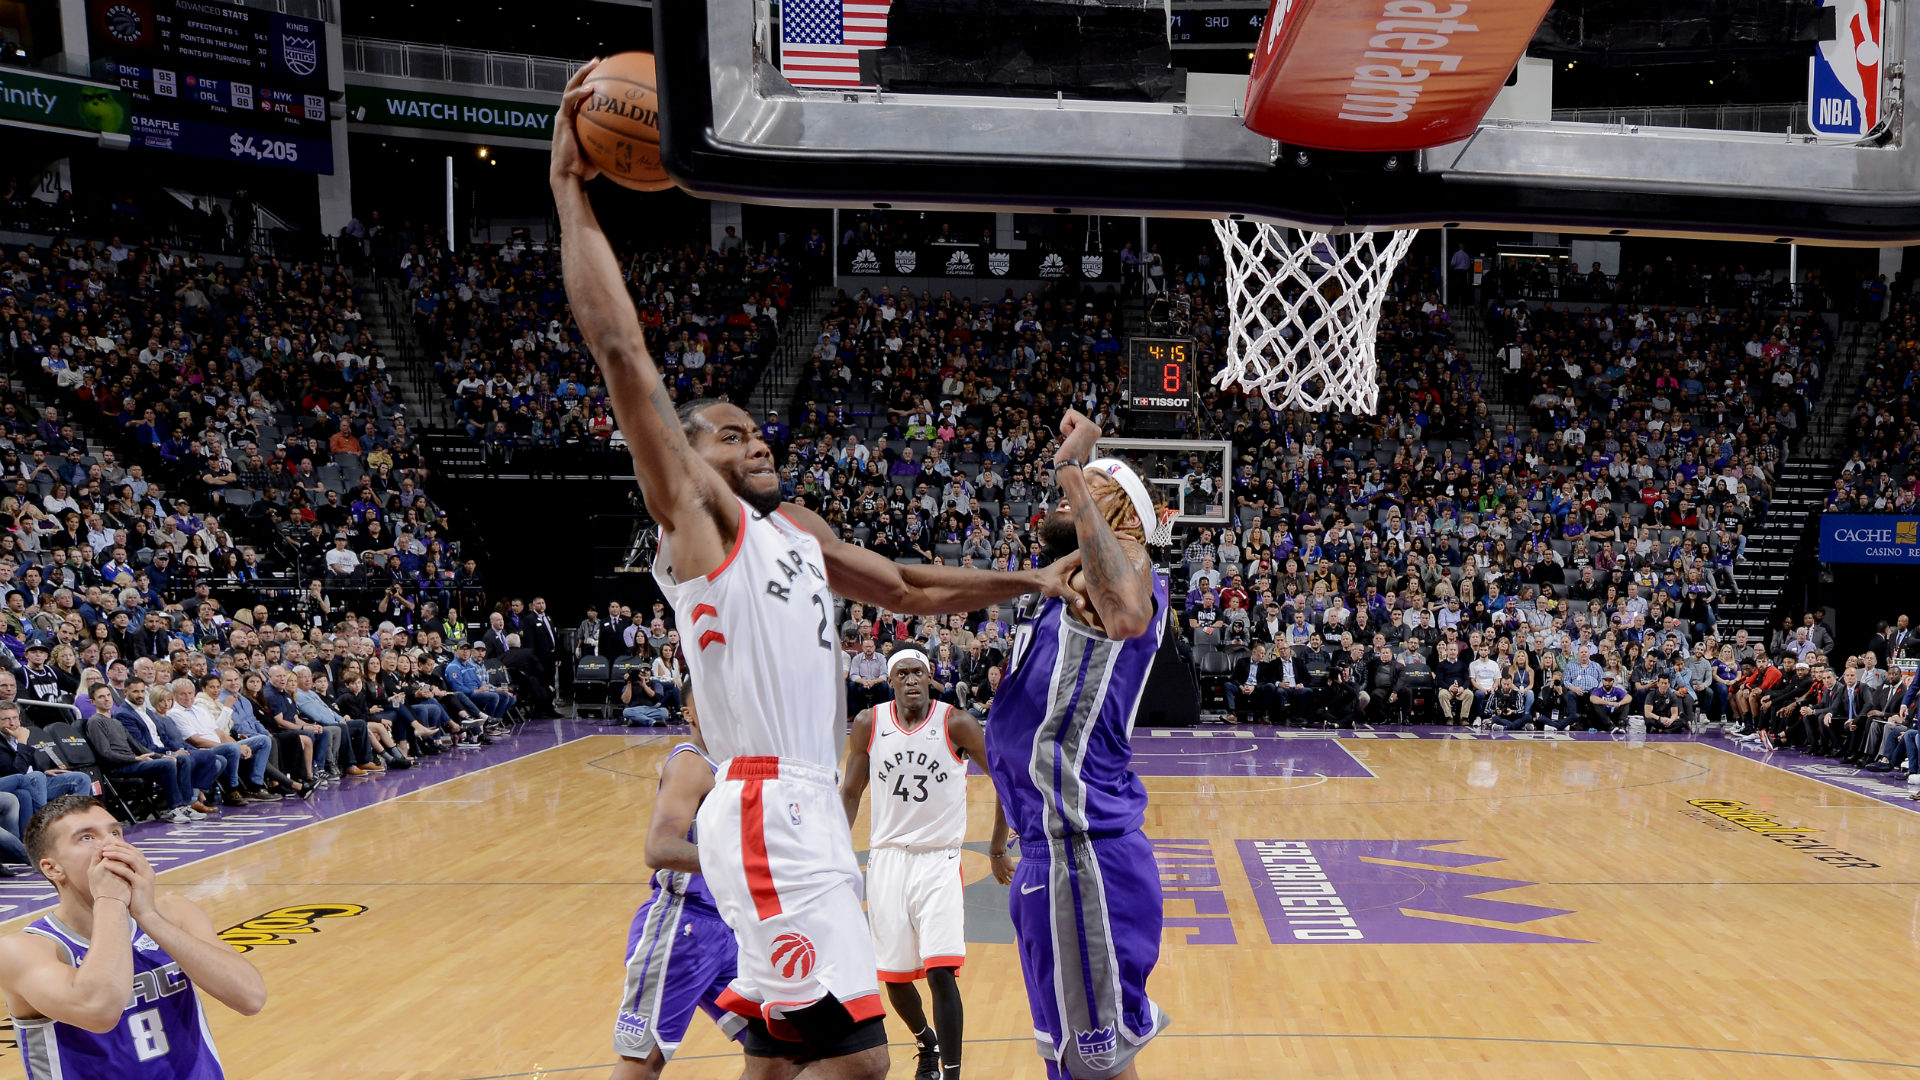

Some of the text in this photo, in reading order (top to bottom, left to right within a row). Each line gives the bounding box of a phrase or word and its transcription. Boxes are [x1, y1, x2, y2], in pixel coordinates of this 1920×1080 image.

[175, 0, 248, 21] ADVANCED STATS
[187, 20, 223, 33] EFFECTIVE
[286, 22, 309, 33] KINGS
[1204, 16, 1230, 27] 3RD
[180, 33, 205, 44] POINTS
[215, 39, 228, 48] THE
[229, 42, 248, 51] PAINT
[179, 47, 202, 57] POINTS
[286, 50, 315, 63] KINGS
[1338, 0, 1480, 123] ateFarm
[119, 65, 171, 81] OKC 95
[120, 78, 140, 89] CLE
[199, 78, 250, 95] DET 103
[132, 92, 151, 100] FINAL
[200, 91, 219, 102] ORL
[273, 90, 322, 107] NYK 112
[210, 105, 228, 114] FINAL
[274, 104, 322, 119] ATL 107
[386, 98, 549, 129] WATCH HOLIDAY
[1819, 98, 1853, 126] NBA
[140, 117, 180, 131] RAFFLE
[284, 117, 301, 125] FINAL
[229, 132, 298, 162] $4,205
[851, 260, 881, 270] Sports
[945, 261, 975, 271] Sports
[1038, 263, 1064, 273] Sport
[1149, 345, 1185, 362] 4:15
[1163, 363, 1181, 393] 8
[1149, 397, 1190, 408] TISSOT
[1834, 528, 1892, 543] CACHE
[1866, 547, 1902, 557] CASINO
[878, 750, 948, 783] RAPTORS
[892, 774, 929, 803] 43
[1761, 832, 1882, 869] CENTER
[1253, 840, 1365, 940] SACRAMENTO
[124, 961, 188, 1011] AC
[127, 1006, 171, 1063] 8
[616, 1021, 644, 1037] SAC
[1079, 1038, 1117, 1056] SAC
